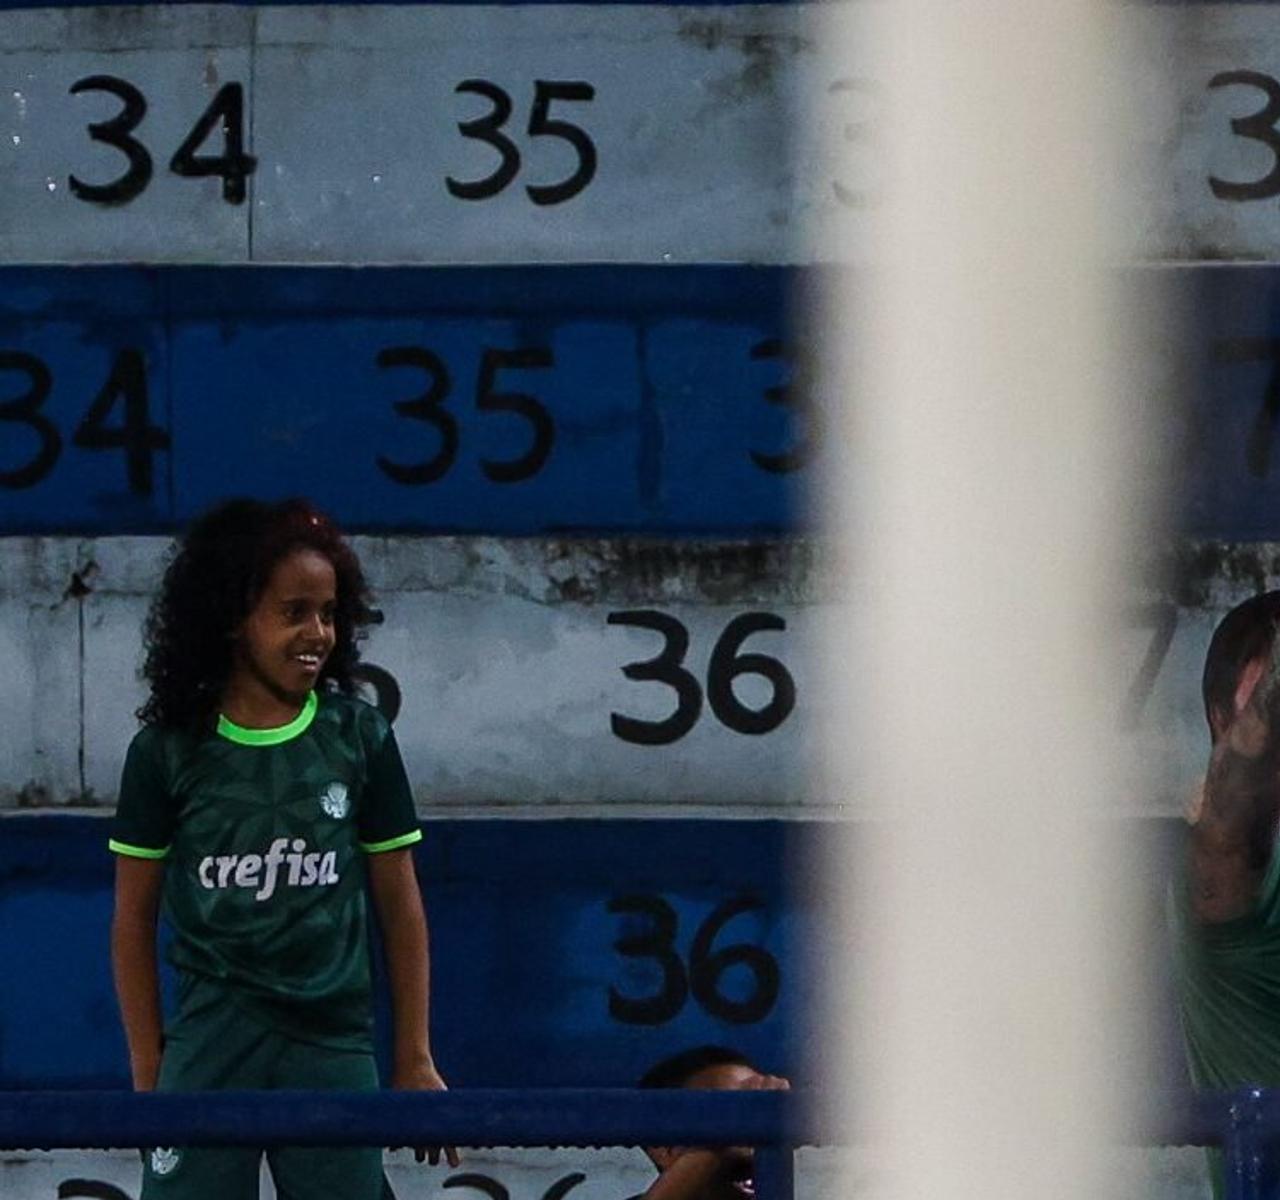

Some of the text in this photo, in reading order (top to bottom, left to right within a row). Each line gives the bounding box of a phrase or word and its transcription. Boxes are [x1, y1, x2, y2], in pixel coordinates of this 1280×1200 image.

[68, 75, 258, 206] 34
[445, 79, 599, 205] 35
[377, 346, 557, 485] 35
[606, 611, 797, 746] 36
[200, 837, 340, 902] crefisa
[606, 893, 781, 1026] 36
